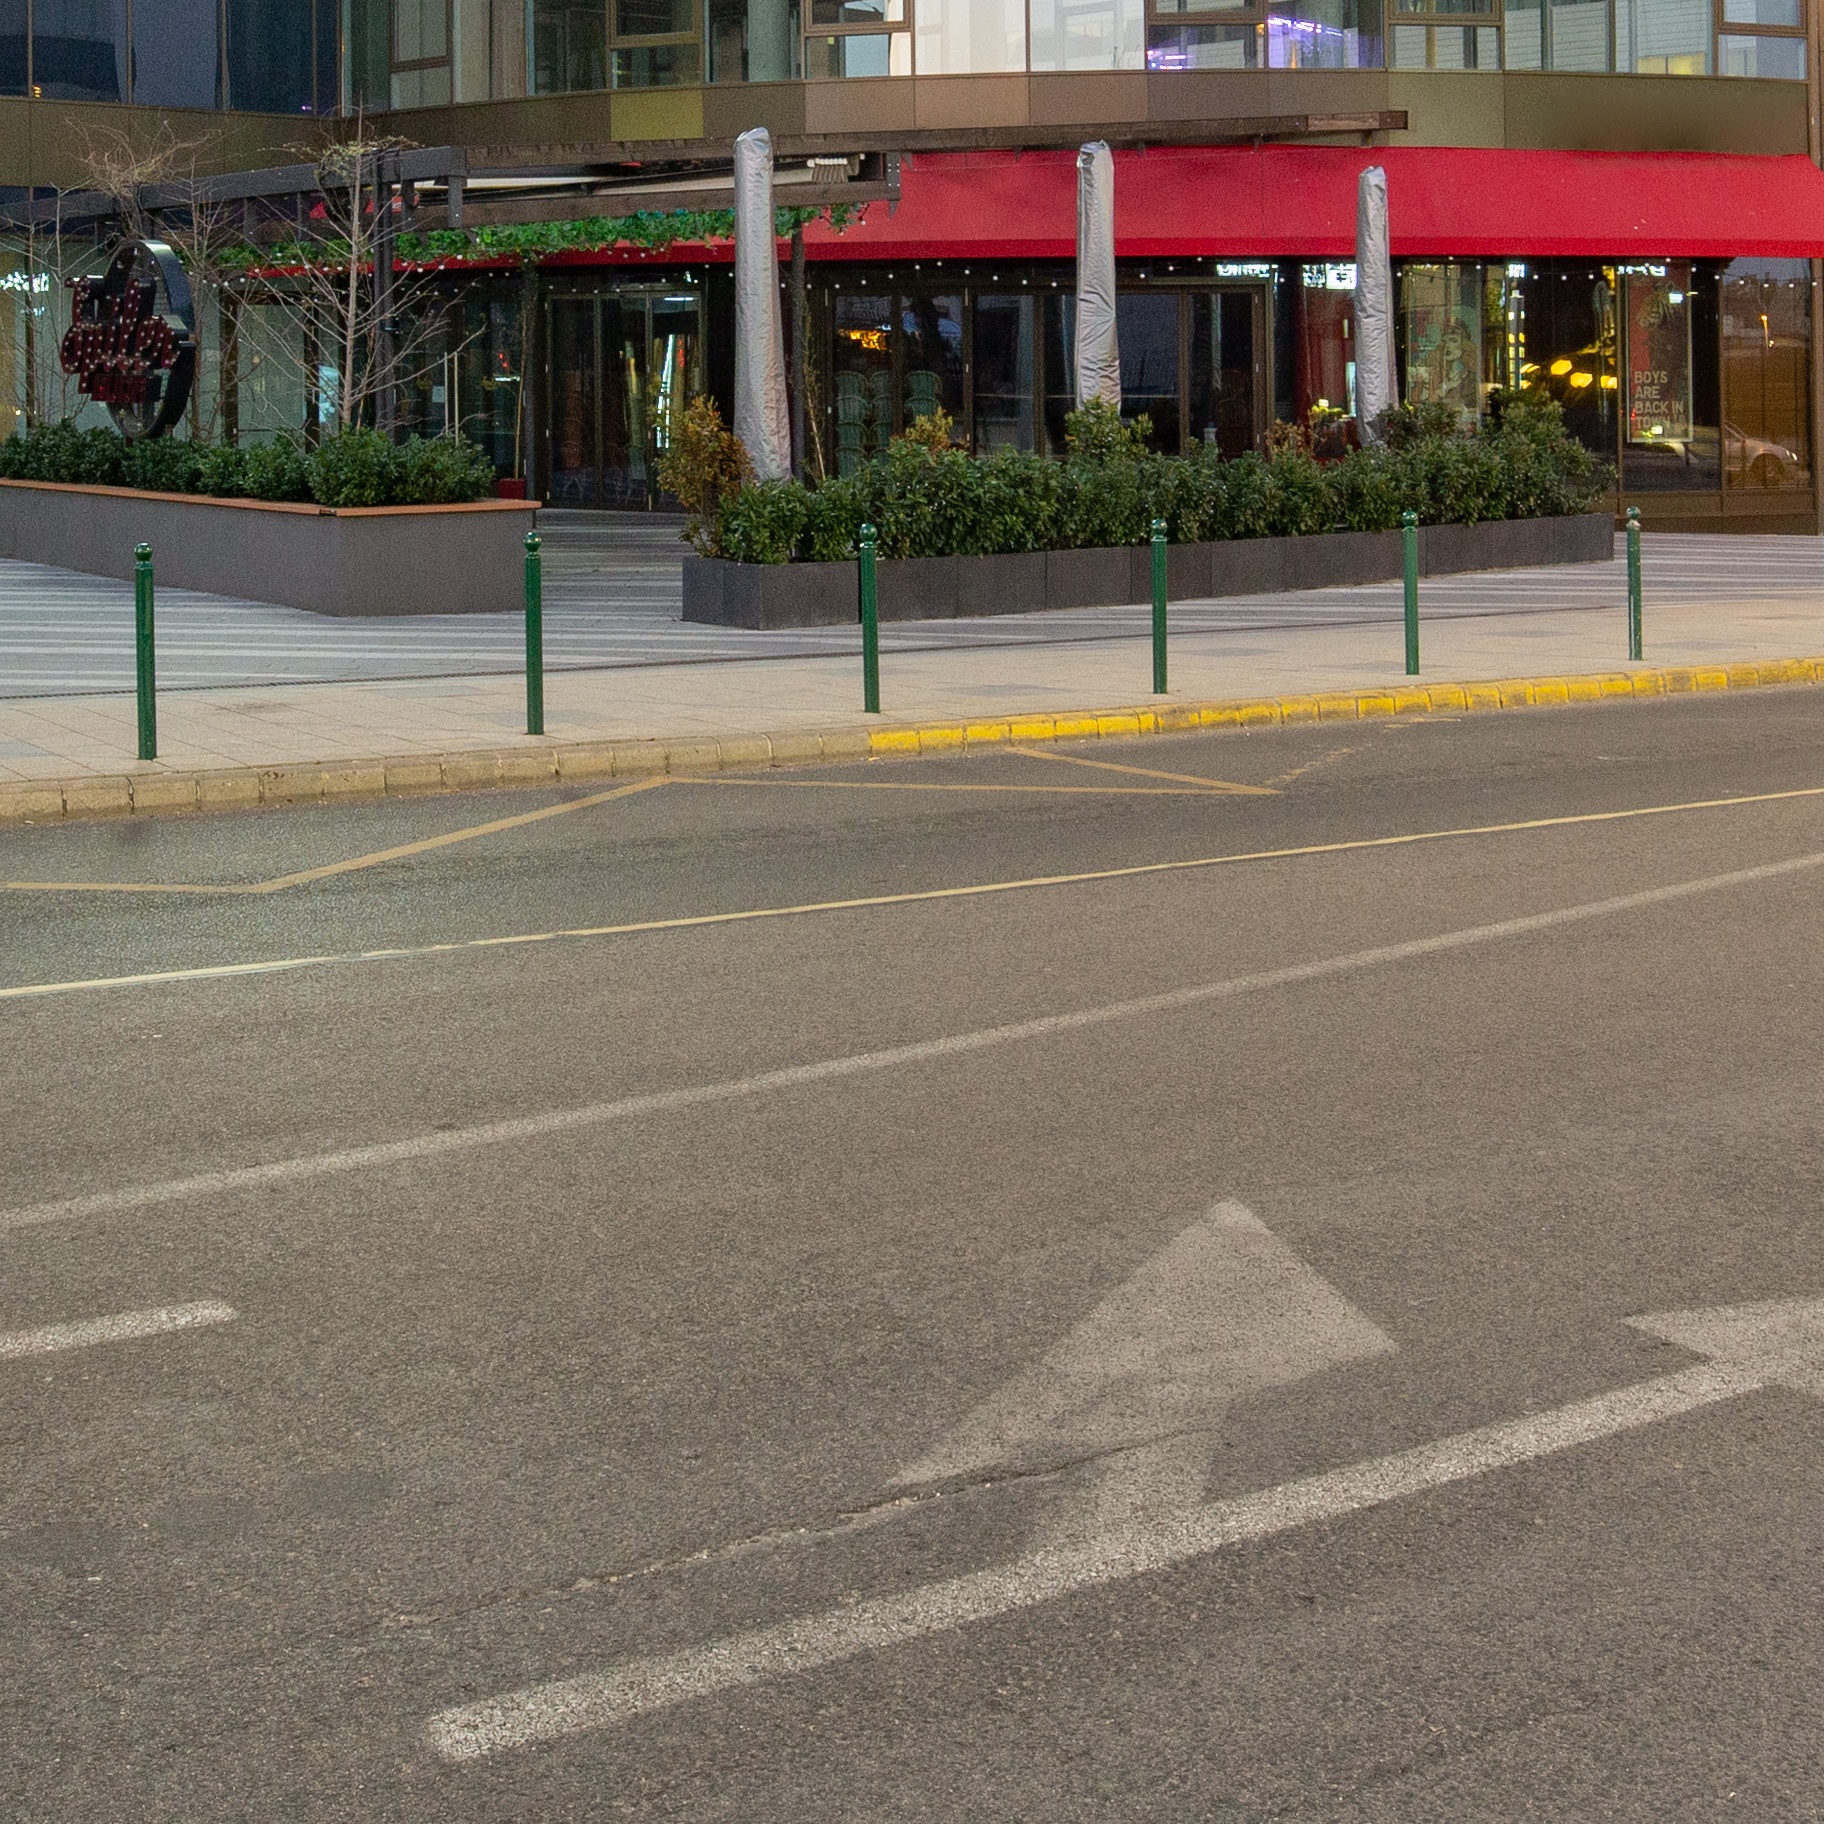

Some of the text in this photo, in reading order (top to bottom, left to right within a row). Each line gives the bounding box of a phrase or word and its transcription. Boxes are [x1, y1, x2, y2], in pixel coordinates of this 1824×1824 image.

[1634, 371, 1668, 384] BOYS
[1635, 386, 1660, 399] ARE
[1635, 400, 1684, 414] BACK IN
